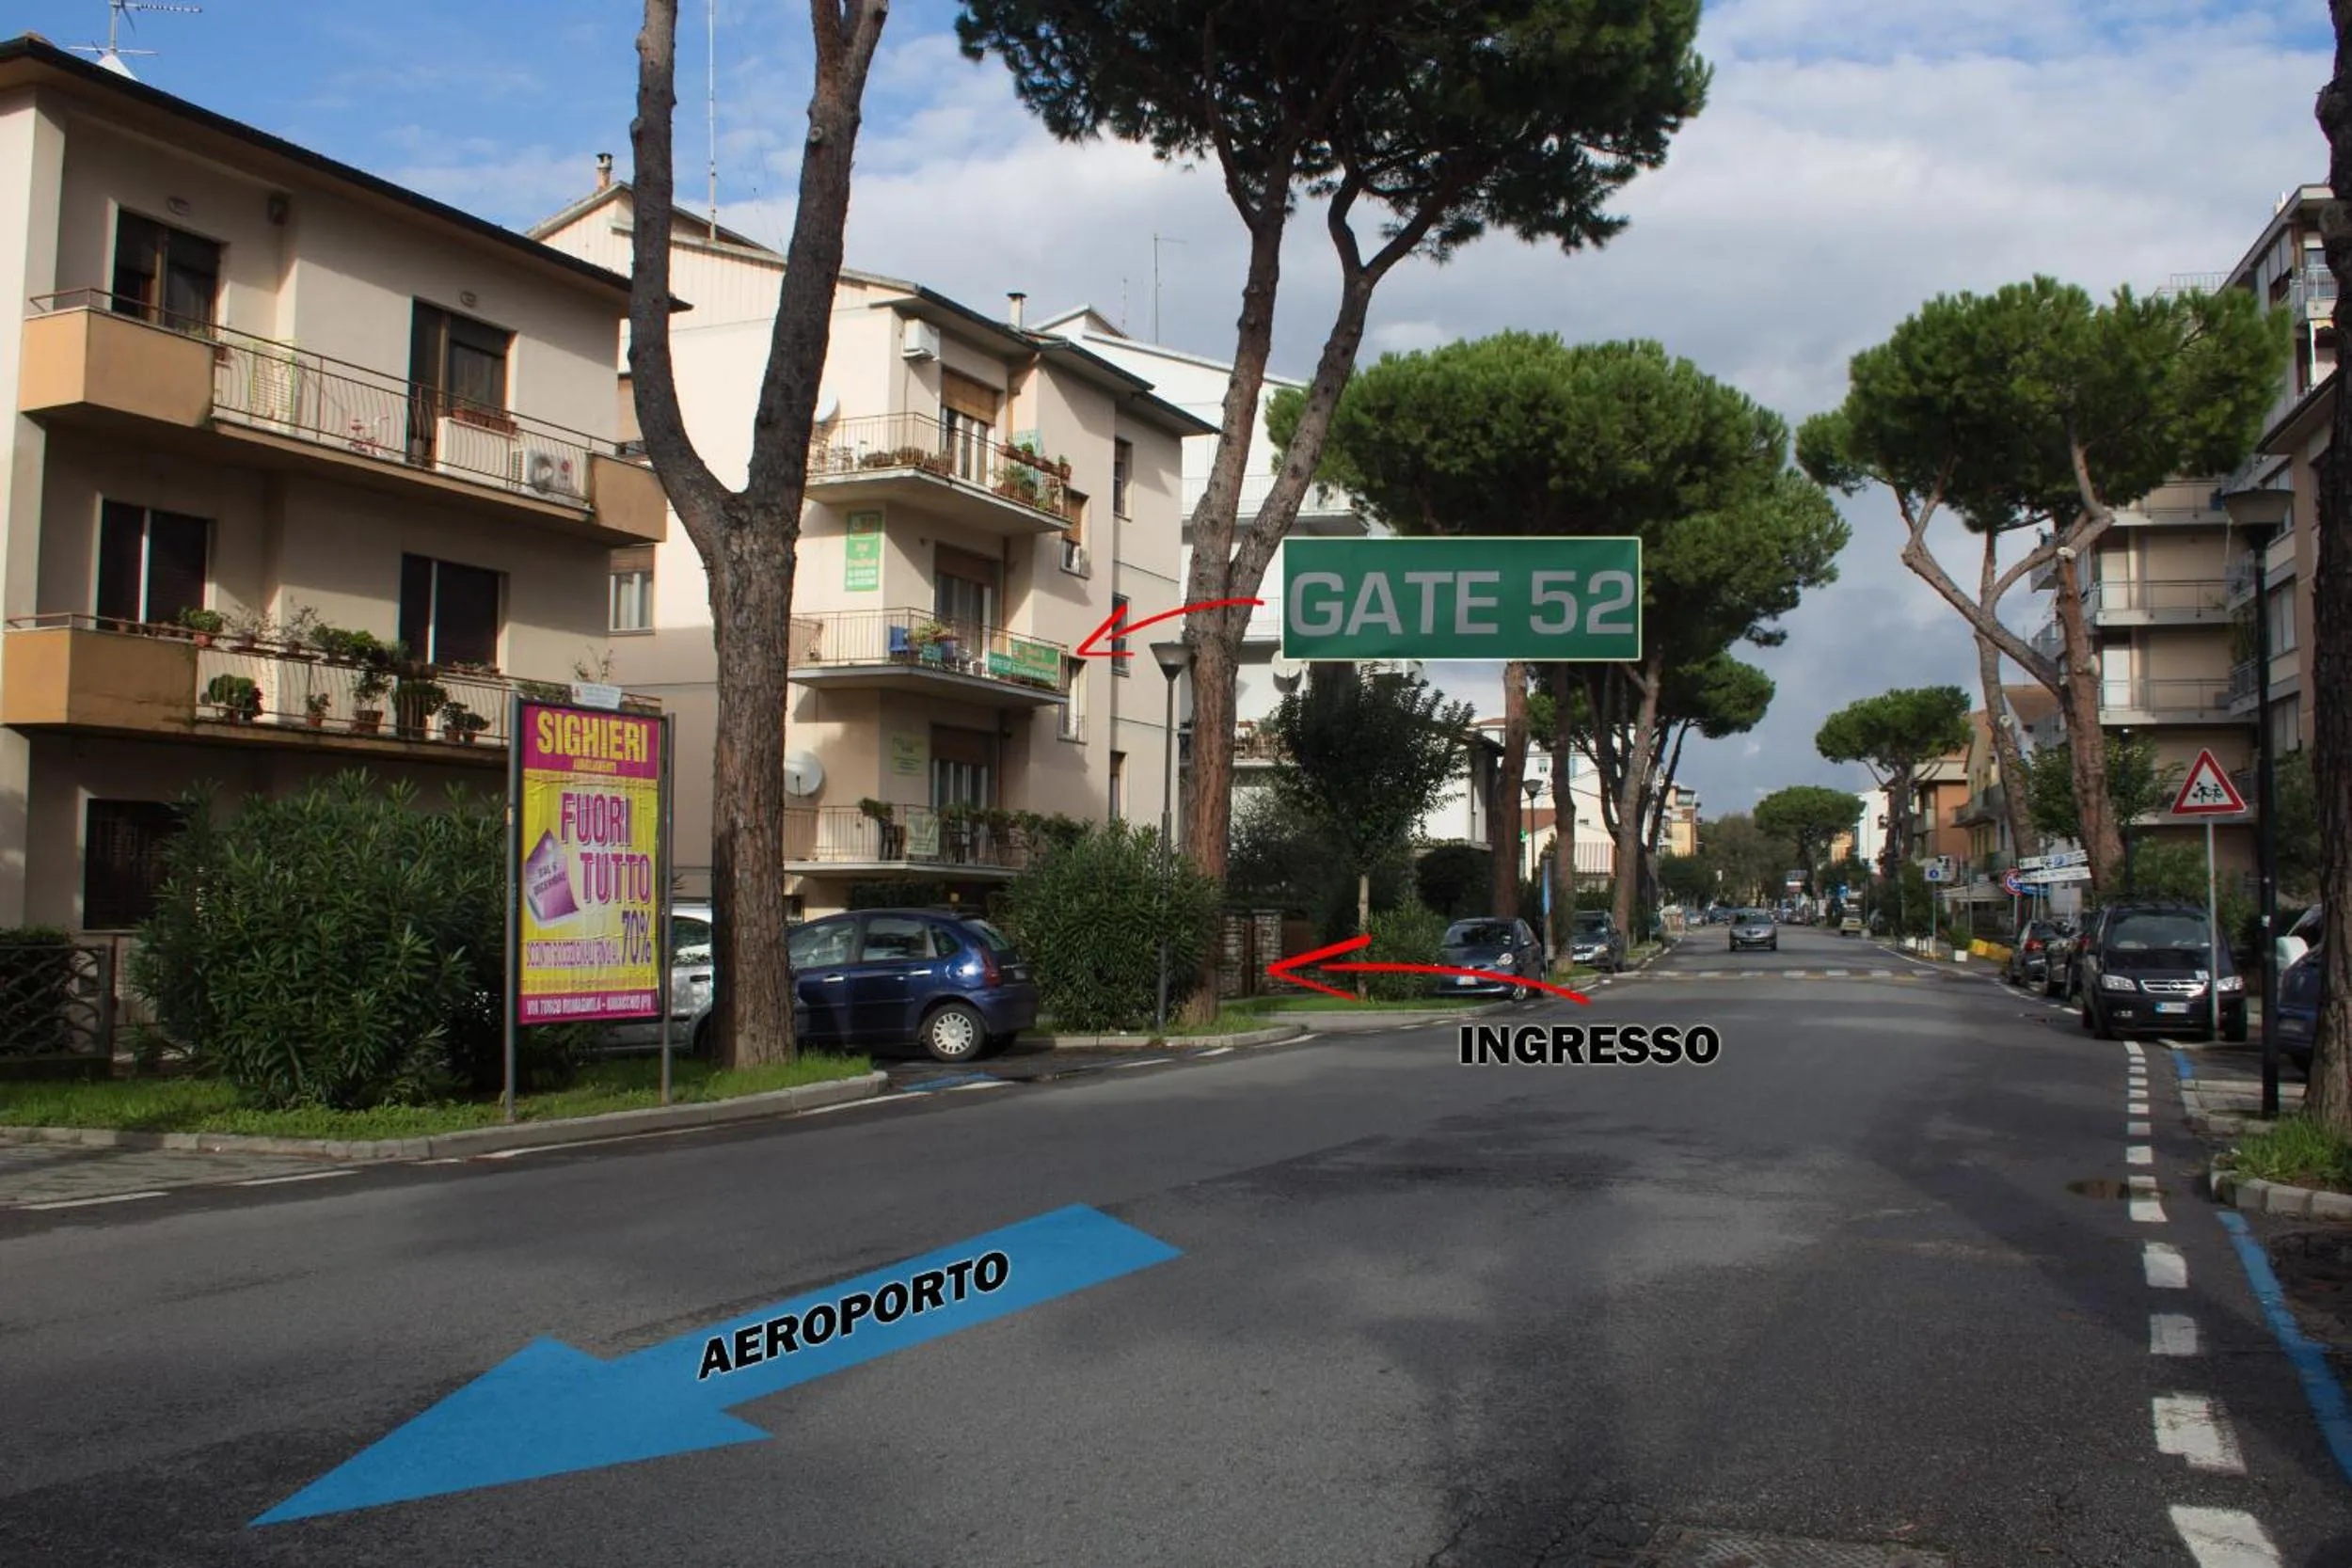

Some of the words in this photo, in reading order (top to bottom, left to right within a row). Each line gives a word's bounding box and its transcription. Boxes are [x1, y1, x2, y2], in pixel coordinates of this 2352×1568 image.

[536, 710, 648, 763] SIGHIERI
[560, 792, 632, 847] FUORI
[579, 851, 653, 905] TUTTO
[621, 910, 652, 967] 70%
